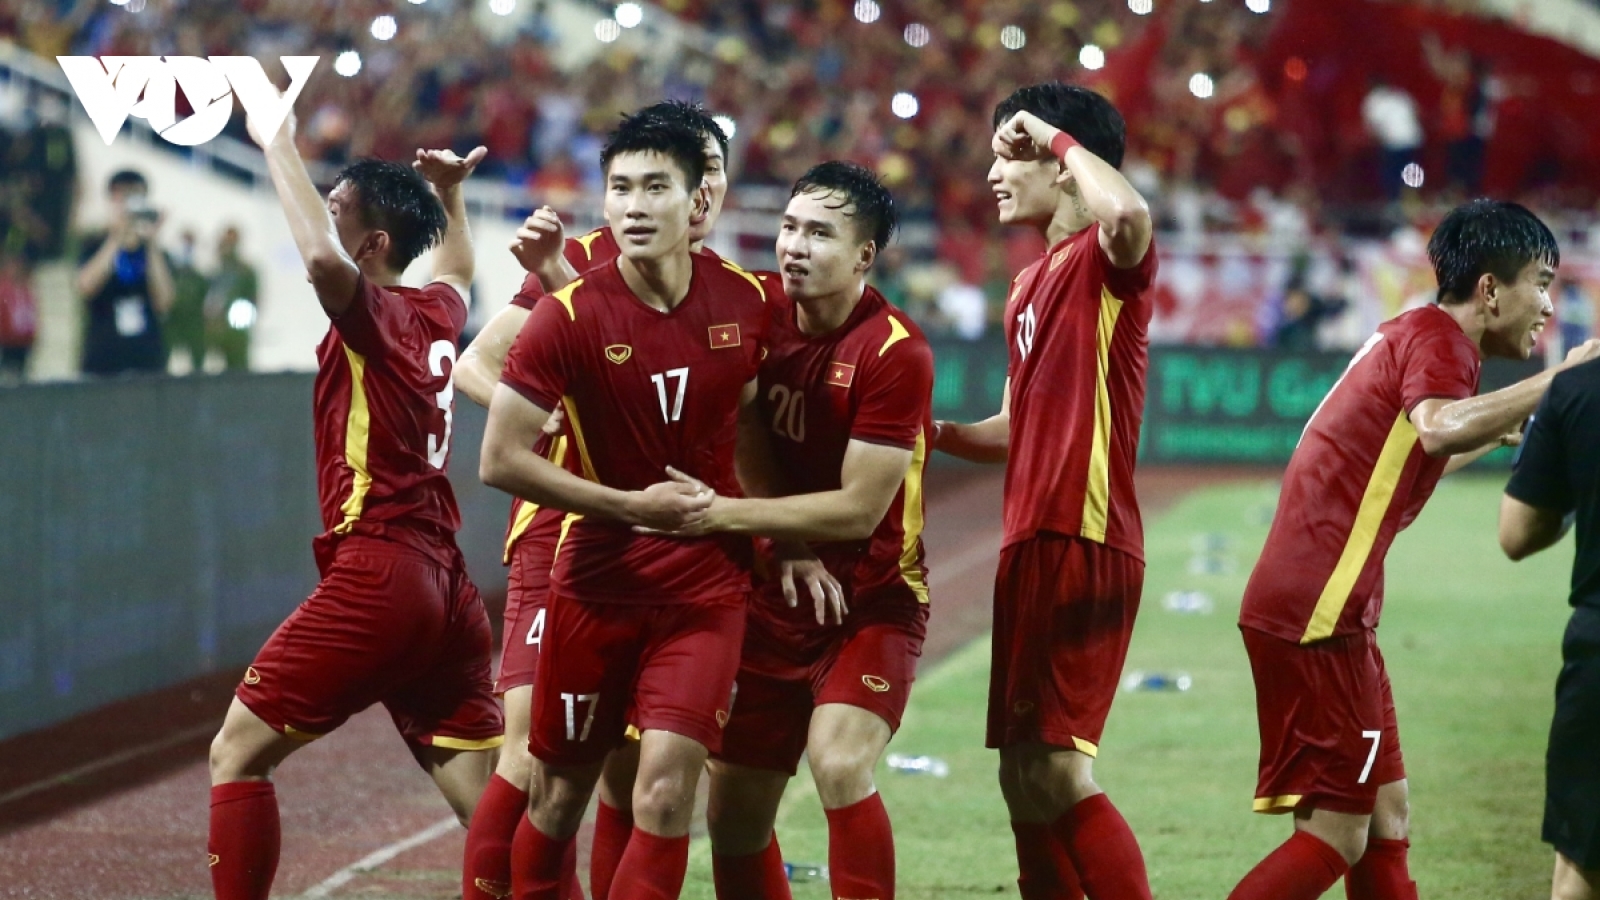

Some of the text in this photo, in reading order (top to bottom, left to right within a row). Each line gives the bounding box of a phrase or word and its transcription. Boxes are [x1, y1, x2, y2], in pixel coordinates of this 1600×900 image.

[1017, 302, 1036, 362] 19
[428, 339, 456, 469] 3
[651, 367, 689, 424] 17
[768, 384, 805, 443] 20
[525, 607, 547, 655] 4
[560, 692, 600, 742] 17
[1357, 730, 1381, 783] 7
